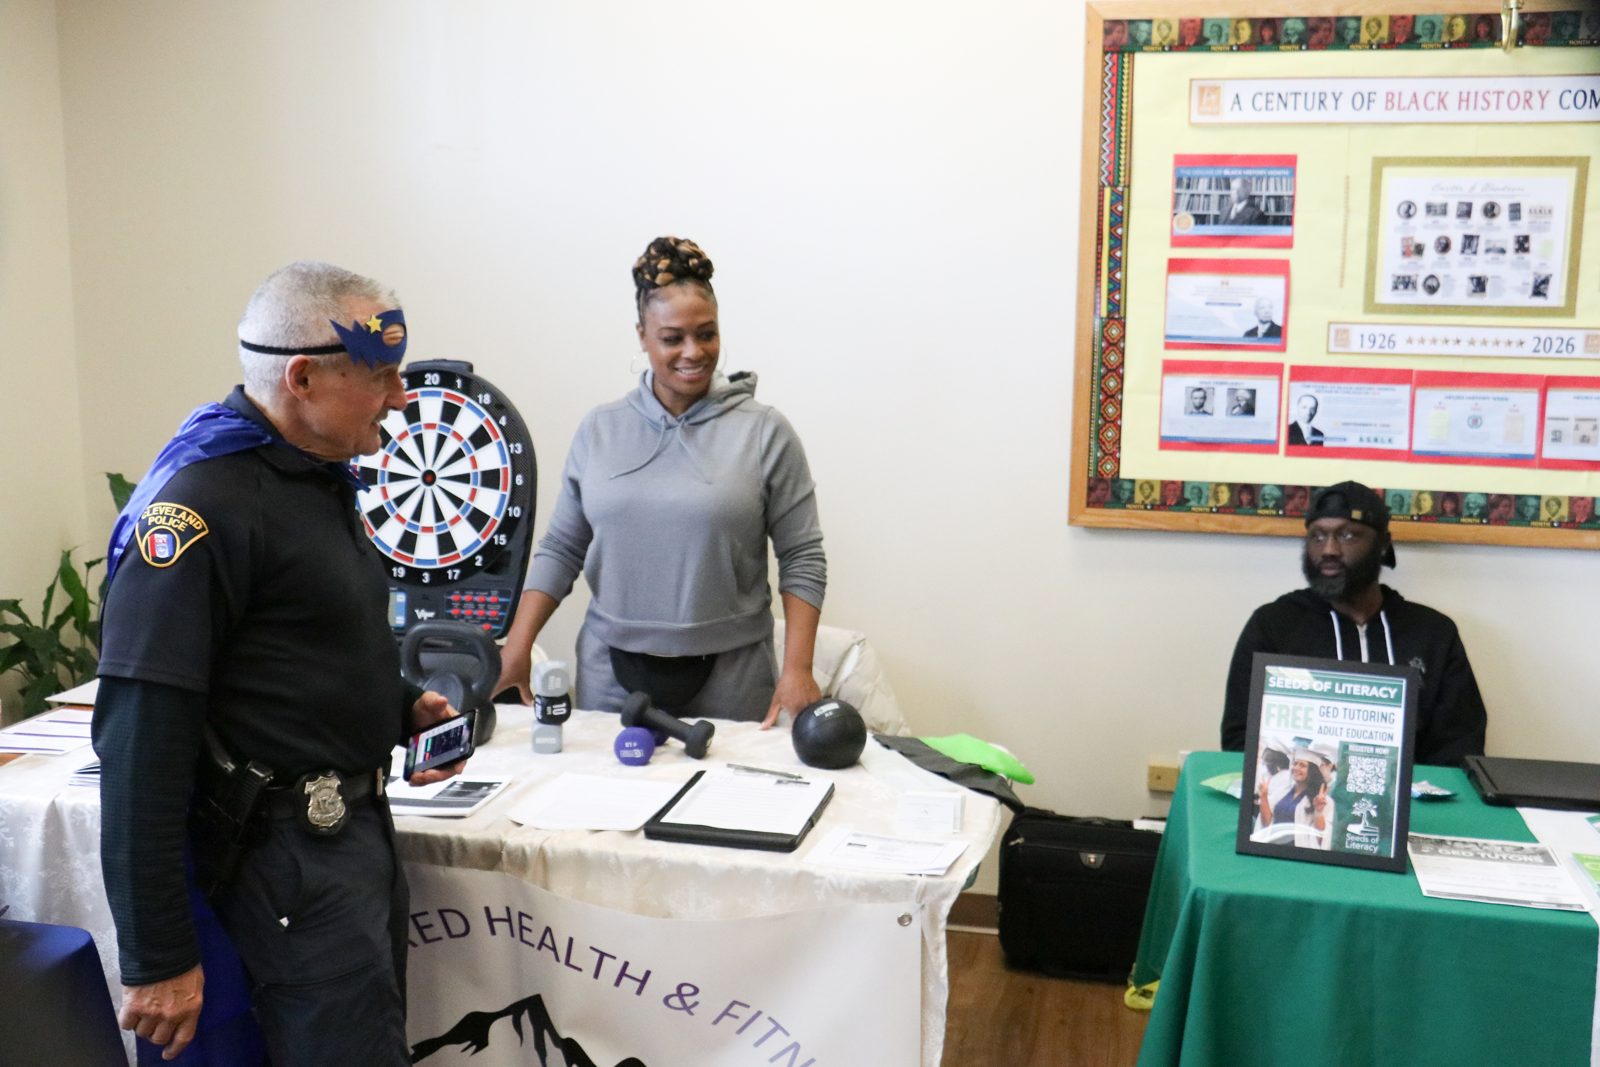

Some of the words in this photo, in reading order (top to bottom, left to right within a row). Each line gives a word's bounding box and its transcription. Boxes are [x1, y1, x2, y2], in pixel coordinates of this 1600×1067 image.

[1230, 93, 1243, 111] A
[1252, 92, 1343, 112] CENTURY
[1351, 91, 1377, 111] OF
[1384, 91, 1449, 111] BLACK
[1457, 90, 1550, 111] HISTORY
[1359, 333, 1397, 350] 1926
[1532, 336, 1576, 354] 2026
[424, 373, 440, 385] 20
[456, 379, 462, 389] 1
[478, 394, 491, 404] 18
[499, 416, 507, 426] 4
[509, 444, 522, 454] 13
[515, 475, 523, 485] 6
[508, 506, 520, 517] 10
[141, 506, 203, 531] CLEVELAND
[148, 516, 188, 532] POLICE
[493, 535, 507, 545] 15
[475, 556, 483, 566] 2
[392, 567, 406, 578] 19
[422, 572, 430, 583] 3
[447, 570, 461, 580] 17
[1268, 676, 1312, 690] SEEDS
[1312, 680, 1333, 692] OF
[1334, 682, 1398, 699] LITERACY
[1264, 702, 1314, 731] FREE
[1319, 705, 1339, 718] GED
[1343, 707, 1396, 724] TUTORING
[1317, 725, 1343, 738] ADULT
[1346, 728, 1394, 743] EDUCATION
[1346, 832, 1369, 843] Seeds
[1371, 834, 1379, 844] of
[1345, 841, 1379, 854] Literacy
[406, 908, 471, 948] ED
[484, 906, 652, 996] HEALTH
[662, 982, 700, 1016] &
